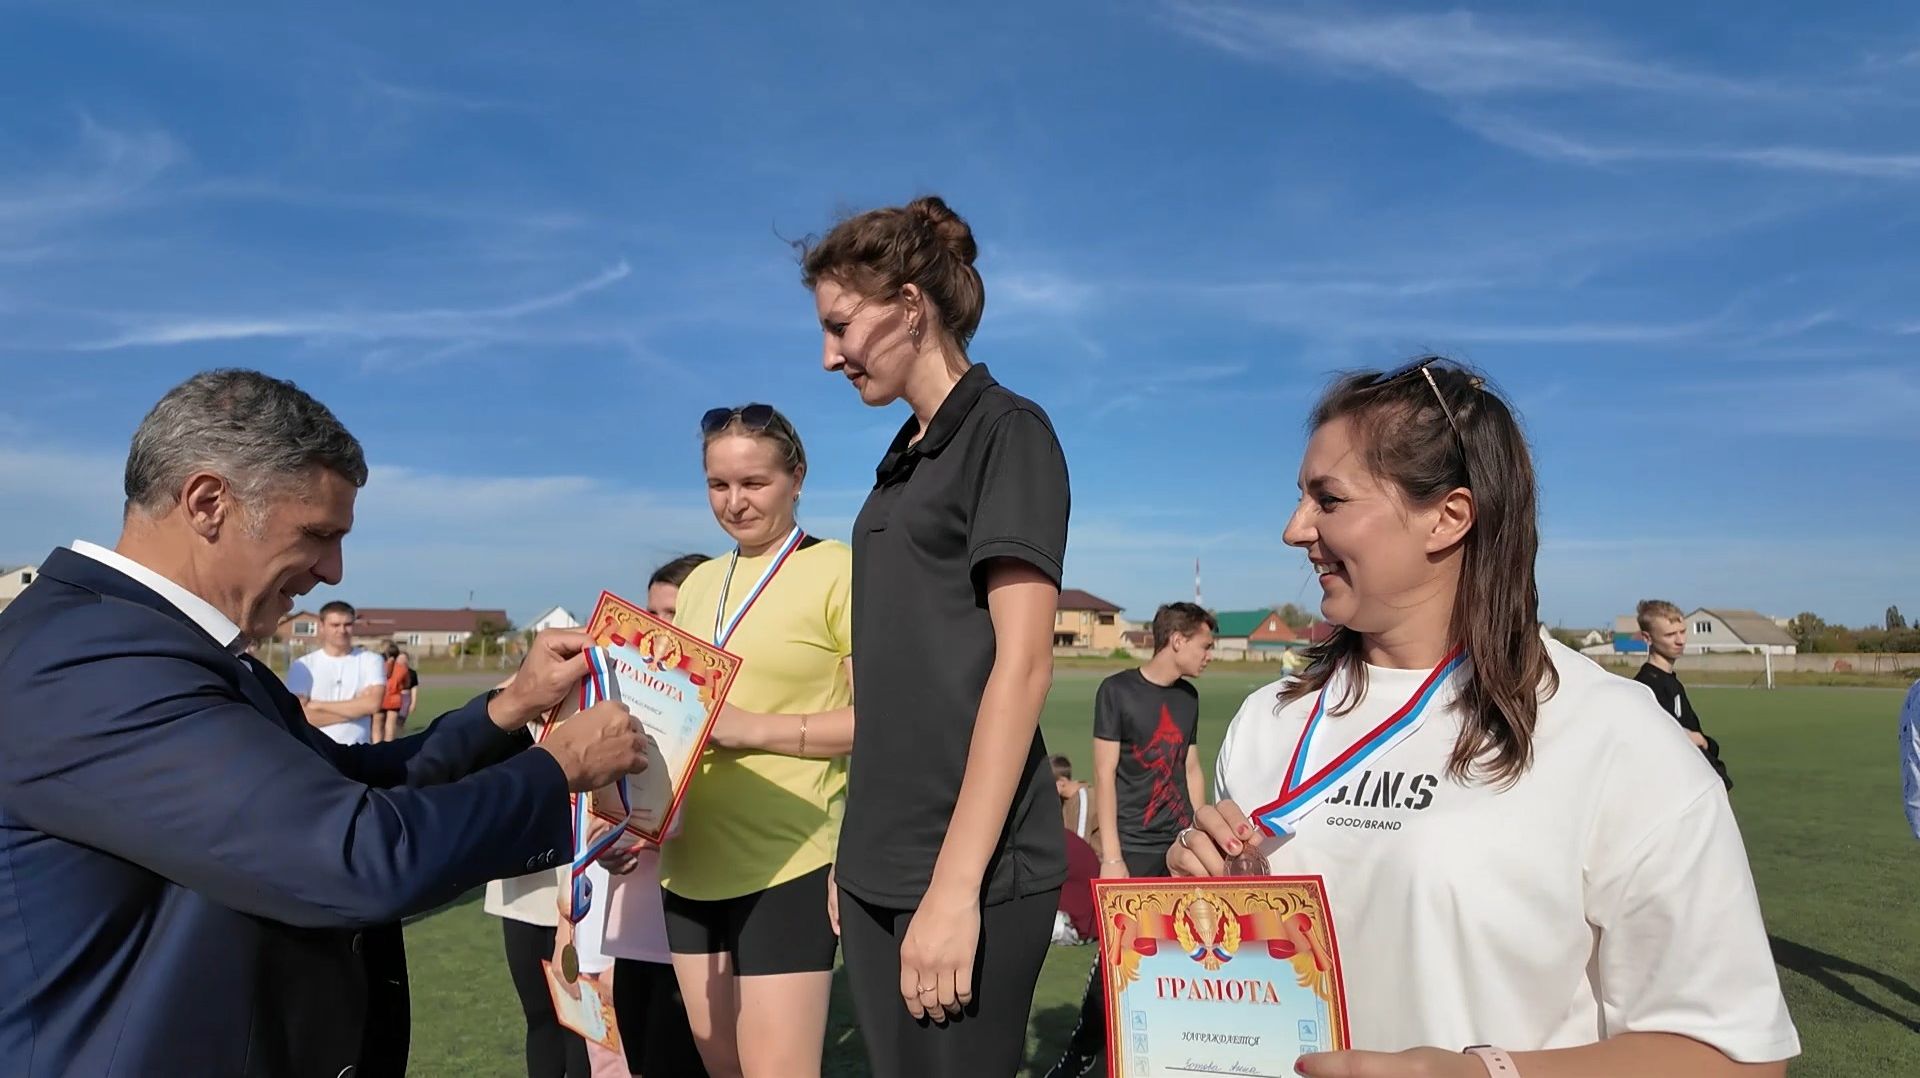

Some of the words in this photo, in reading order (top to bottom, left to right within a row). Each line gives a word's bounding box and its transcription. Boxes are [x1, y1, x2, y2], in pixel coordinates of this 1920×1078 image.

[612, 658, 684, 703] ГРАМОТА
[1326, 816, 1401, 830] GOOD/BRAND
[1156, 976, 1279, 1004] ГРАМОТА
[1181, 1031, 1261, 1047] НАГРАЖДАЕТСЯ
